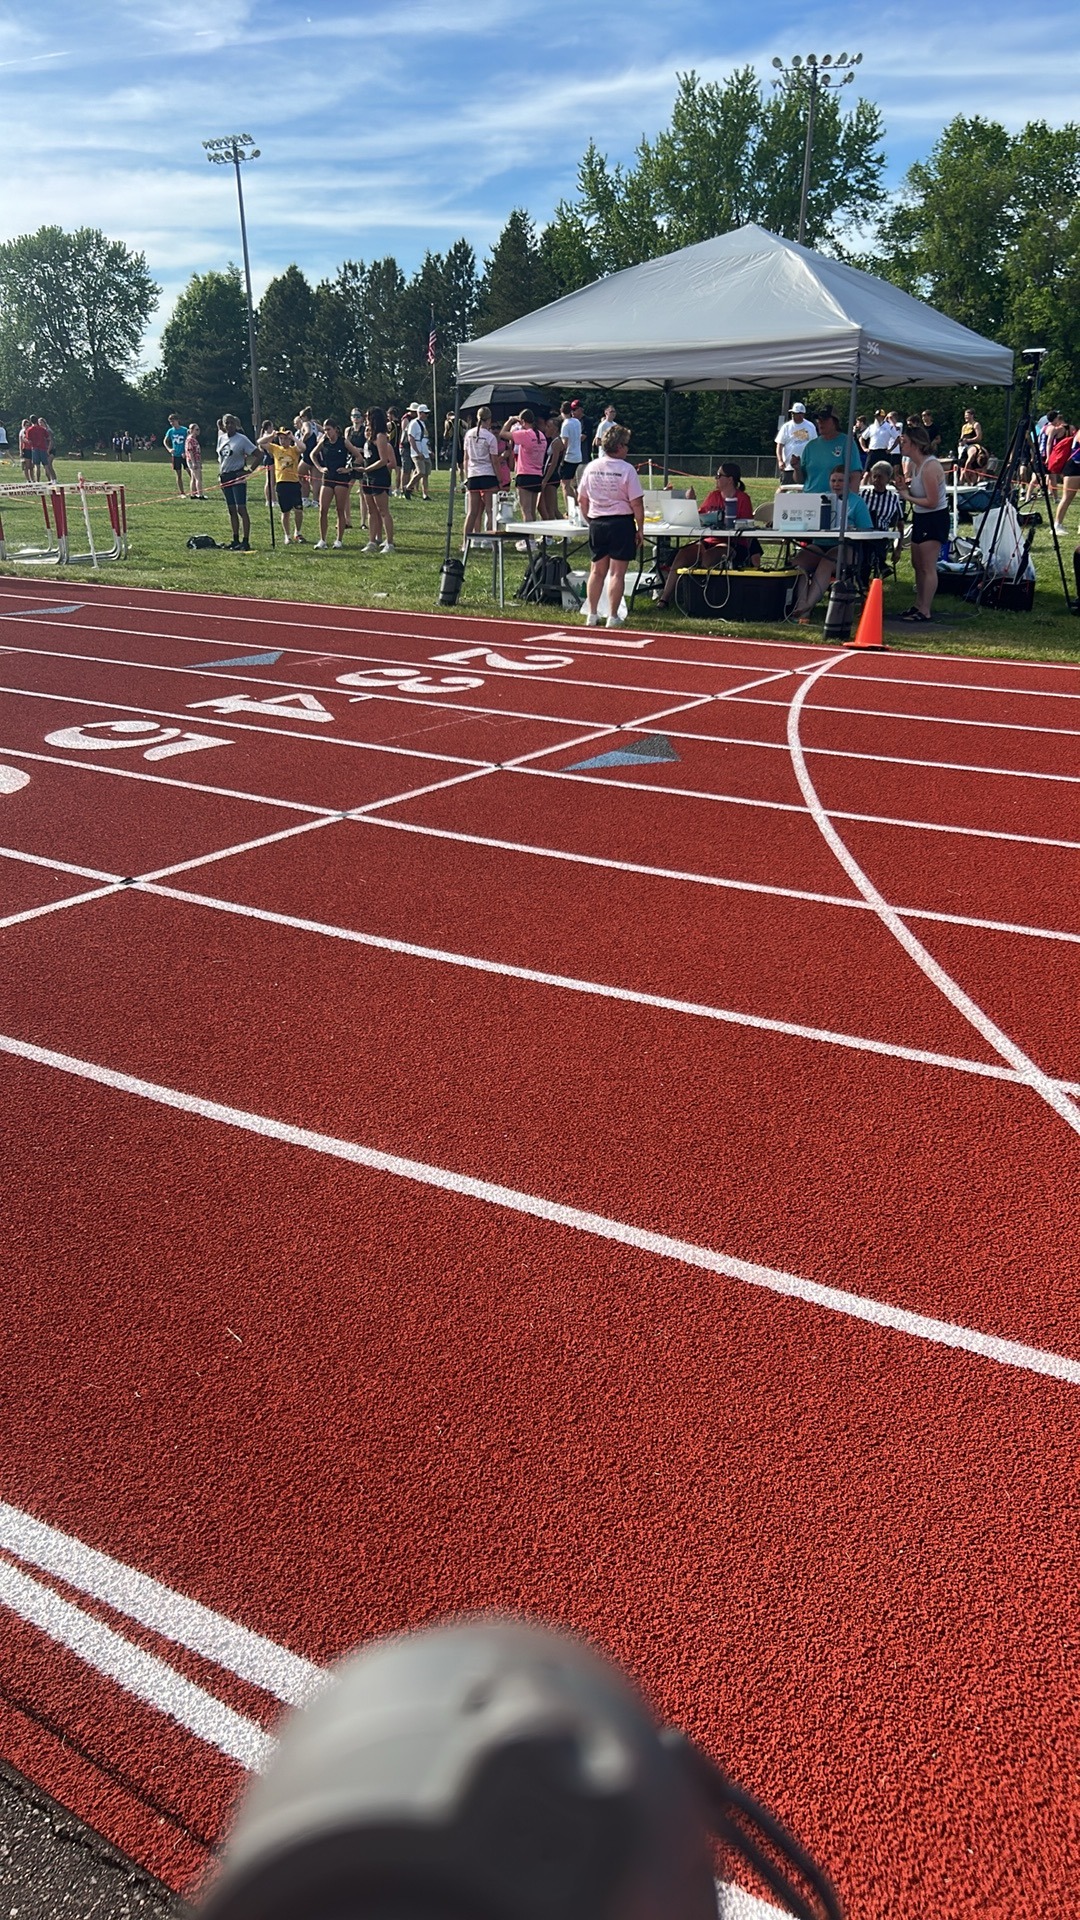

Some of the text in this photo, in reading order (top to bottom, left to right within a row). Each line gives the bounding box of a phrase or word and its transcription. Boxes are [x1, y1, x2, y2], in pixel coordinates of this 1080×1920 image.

[522, 632, 655, 648] 1
[427, 648, 574, 671] 2
[335, 668, 485, 694] 3
[185, 693, 335, 723] 4
[44, 720, 236, 761] 5
